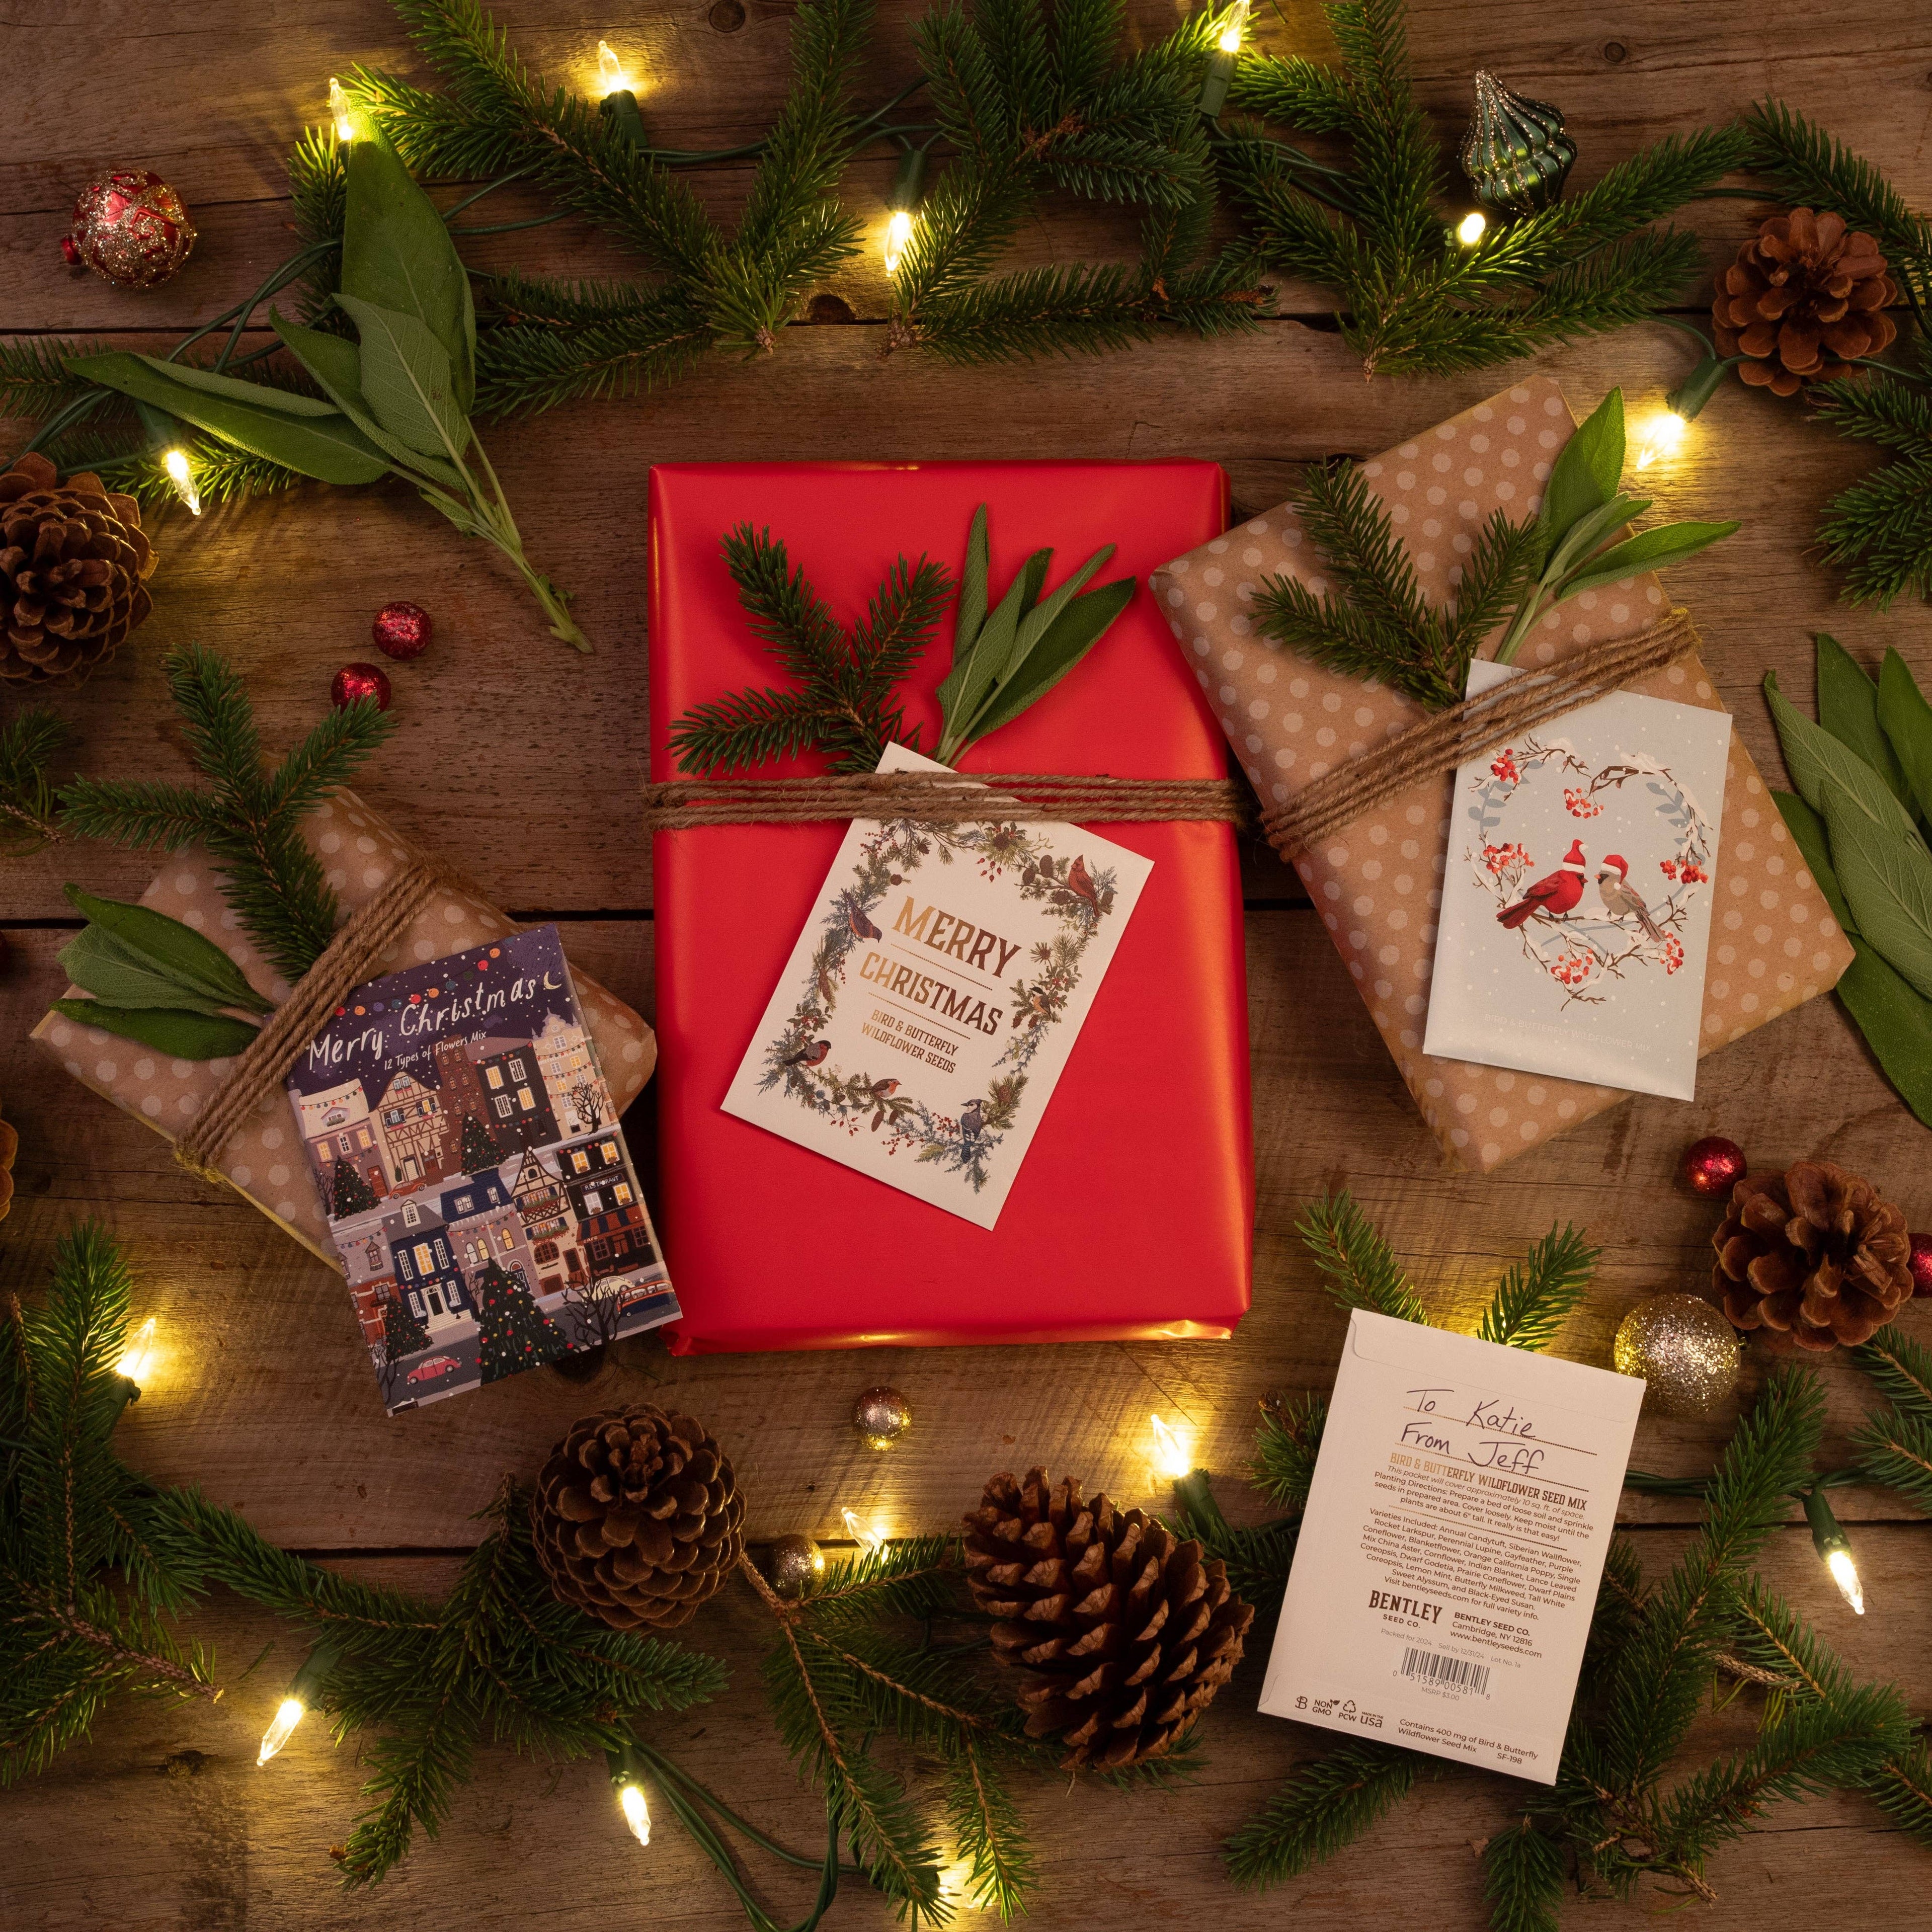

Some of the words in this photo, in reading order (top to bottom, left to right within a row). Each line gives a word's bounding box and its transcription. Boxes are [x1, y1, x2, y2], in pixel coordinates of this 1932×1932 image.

[891, 895, 1022, 979] MERRY
[859, 951, 1003, 1036] CHRISTMAS
[308, 1027, 383, 1070] Merry
[401, 977, 537, 1036] Christmas
[870, 1009, 896, 1028] BIRD
[895, 1020, 904, 1032] &
[904, 1024, 959, 1057] BUTTERFLY
[1484, 1012, 1507, 1025] BIRD
[1517, 1019, 1569, 1037] BUTTERFLY
[1570, 1028, 1634, 1050] WILDFLOWER
[1634, 1041, 1652, 1053] MIX
[384, 1059, 392, 1071] 12
[395, 1052, 419, 1070] Types
[422, 1044, 431, 1061] of
[435, 1036, 467, 1056] Flowers
[470, 1029, 487, 1043] Mix
[861, 1022, 925, 1060] WILDFLOWER
[924, 1051, 956, 1074] SEEDS
[585, 1175, 619, 1190] RETARANT
[1406, 1389, 1455, 1412] To
[1466, 1399, 1536, 1438] Katie
[1400, 1421, 1450, 1454] From
[1467, 1441, 1544, 1474] Jeff
[1374, 1471, 1406, 1485] Planting
[1407, 1479, 1448, 1495] Directions:
[1449, 1489, 1479, 1502] Prepare
[1486, 1498, 1502, 1508] bed
[1511, 1505, 1532, 1516] loose
[1533, 1511, 1547, 1519] soil
[1547, 1515, 1563, 1523] and
[1563, 1519, 1593, 1531] sprinkle
[1387, 1465, 1402, 1474] This
[1402, 1470, 1429, 1481] packet
[1444, 1481, 1466, 1490] cover
[1466, 1486, 1521, 1504] approximately
[1531, 1502, 1541, 1510] sq.
[1560, 1509, 1584, 1520] space.
[1389, 1452, 1412, 1467] BIRD
[1413, 1458, 1421, 1469] &
[1423, 1460, 1476, 1483] BUTTERFLY
[1478, 1473, 1540, 1499] WILDFLOWER
[1541, 1490, 1566, 1505] SEED
[1567, 1496, 1588, 1511] MIX
[1374, 1481, 1396, 1491] seeds
[1406, 1489, 1441, 1502] prepared
[1442, 1498, 1460, 1507] area.
[1462, 1502, 1484, 1513] Cover
[1485, 1507, 1512, 1520] loosely.
[1513, 1515, 1533, 1525] Keep
[1534, 1521, 1557, 1531] moist
[1557, 1527, 1575, 1536] until
[1576, 1531, 1589, 1539] the
[1400, 1497, 1424, 1507] plants
[1438, 1506, 1462, 1517] about
[1472, 1514, 1485, 1523] tall.
[1494, 1520, 1515, 1531] really
[1523, 1527, 1540, 1536] that
[1541, 1532, 1560, 1542] easy!
[1362, 1524, 1407, 1542] Coneflower,
[1408, 1536, 1462, 1556] Blanketflower,
[1463, 1550, 1492, 1562] Orange
[1493, 1557, 1528, 1572] California
[1530, 1566, 1556, 1579] Poppy,
[1557, 1573, 1581, 1584] Single
[1370, 1507, 1401, 1521] Varieties
[1403, 1516, 1438, 1531] Included:
[1438, 1525, 1467, 1538] Annual
[1467, 1532, 1507, 1549] Candytuft,
[1508, 1542, 1539, 1556] Siberian
[1541, 1550, 1582, 1567] Wallflower,
[1374, 1517, 1401, 1531] Rocket
[1401, 1524, 1436, 1540] Larkspur,
[1437, 1534, 1474, 1549] Perennial
[1475, 1543, 1502, 1557] Lupine,
[1504, 1551, 1547, 1568] Gayfeather,
[1548, 1561, 1573, 1573] Purple
[1360, 1542, 1398, 1558] Coreopsis,
[1399, 1552, 1423, 1563] Dwarf
[1423, 1558, 1455, 1573] Godetia,
[1457, 1566, 1481, 1578] Prairie
[1482, 1573, 1526, 1590] Coneflower,
[1527, 1584, 1552, 1595] Dwarf
[1552, 1590, 1575, 1601] Plains
[1362, 1534, 1377, 1543] Mix
[1377, 1537, 1399, 1549] China
[1400, 1544, 1422, 1555] Aster,
[1423, 1549, 1466, 1566] Cornflower,
[1468, 1560, 1492, 1572] Indian
[1493, 1566, 1524, 1581] Blanket,
[1525, 1574, 1549, 1585] Lance
[1550, 1580, 1577, 1592] Leaved
[1365, 1553, 1404, 1569] Coreopsis,
[1405, 1562, 1432, 1575] Lemon
[1433, 1570, 1453, 1581] Mint,
[1454, 1575, 1488, 1590] Butterfly
[1488, 1584, 1526, 1599] Milkweed,
[1528, 1593, 1541, 1602] Tall
[1543, 1597, 1565, 1608] White
[1367, 1589, 1443, 1625] BENTLEY
[1384, 1575, 1400, 1586] Visit
[1401, 1580, 1469, 1603] bentleyseeds.com
[1471, 1597, 1482, 1605] for
[1482, 1600, 1495, 1609] full
[1496, 1605, 1522, 1617] variety
[1522, 1610, 1539, 1621] info.
[1391, 1568, 1415, 1580] Sweet
[1415, 1575, 1450, 1590] Alyssum,
[1451, 1585, 1467, 1593] and
[1468, 1587, 1510, 1603] Black-Eyed
[1510, 1598, 1535, 1610] Susan.
[1382, 1613, 1404, 1624] SEED
[1406, 1620, 1420, 1628] CO.
[1452, 1621, 1497, 1639] Cambridge,
[1499, 1632, 1511, 1641] NY
[1512, 1635, 1533, 1646] 12816
[1454, 1611, 1492, 1626] BENTLEY
[1492, 1621, 1515, 1632] SEED
[1516, 1627, 1530, 1636] CO.
[1381, 1628, 1405, 1639] Packed
[1415, 1637, 1432, 1646] 2024
[1437, 1642, 1450, 1650] Sell
[1451, 1645, 1460, 1654] by
[1490, 1655, 1501, 1663] Lot
[1502, 1658, 1513, 1666] No.
[1450, 1630, 1542, 1658] www.bentleyseeds.com
[1312, 1706, 1332, 1716] GMO
[1314, 1699, 1333, 1709] NON
[1421, 1686, 1441, 1696] MSRP
[1338, 1712, 1357, 1722] PCW
[1399, 1718, 1434, 1732] Contains
[1435, 1727, 1452, 1736] 400
[1453, 1733, 1467, 1742] mg
[1478, 1737, 1495, 1748] Bird
[1503, 1744, 1539, 1760] Butterfly
[1398, 1727, 1440, 1743] Wildflower
[1441, 1738, 1462, 1748] Seed
[1463, 1743, 1477, 1753] Mix
[1496, 1752, 1522, 1764] SF-198
